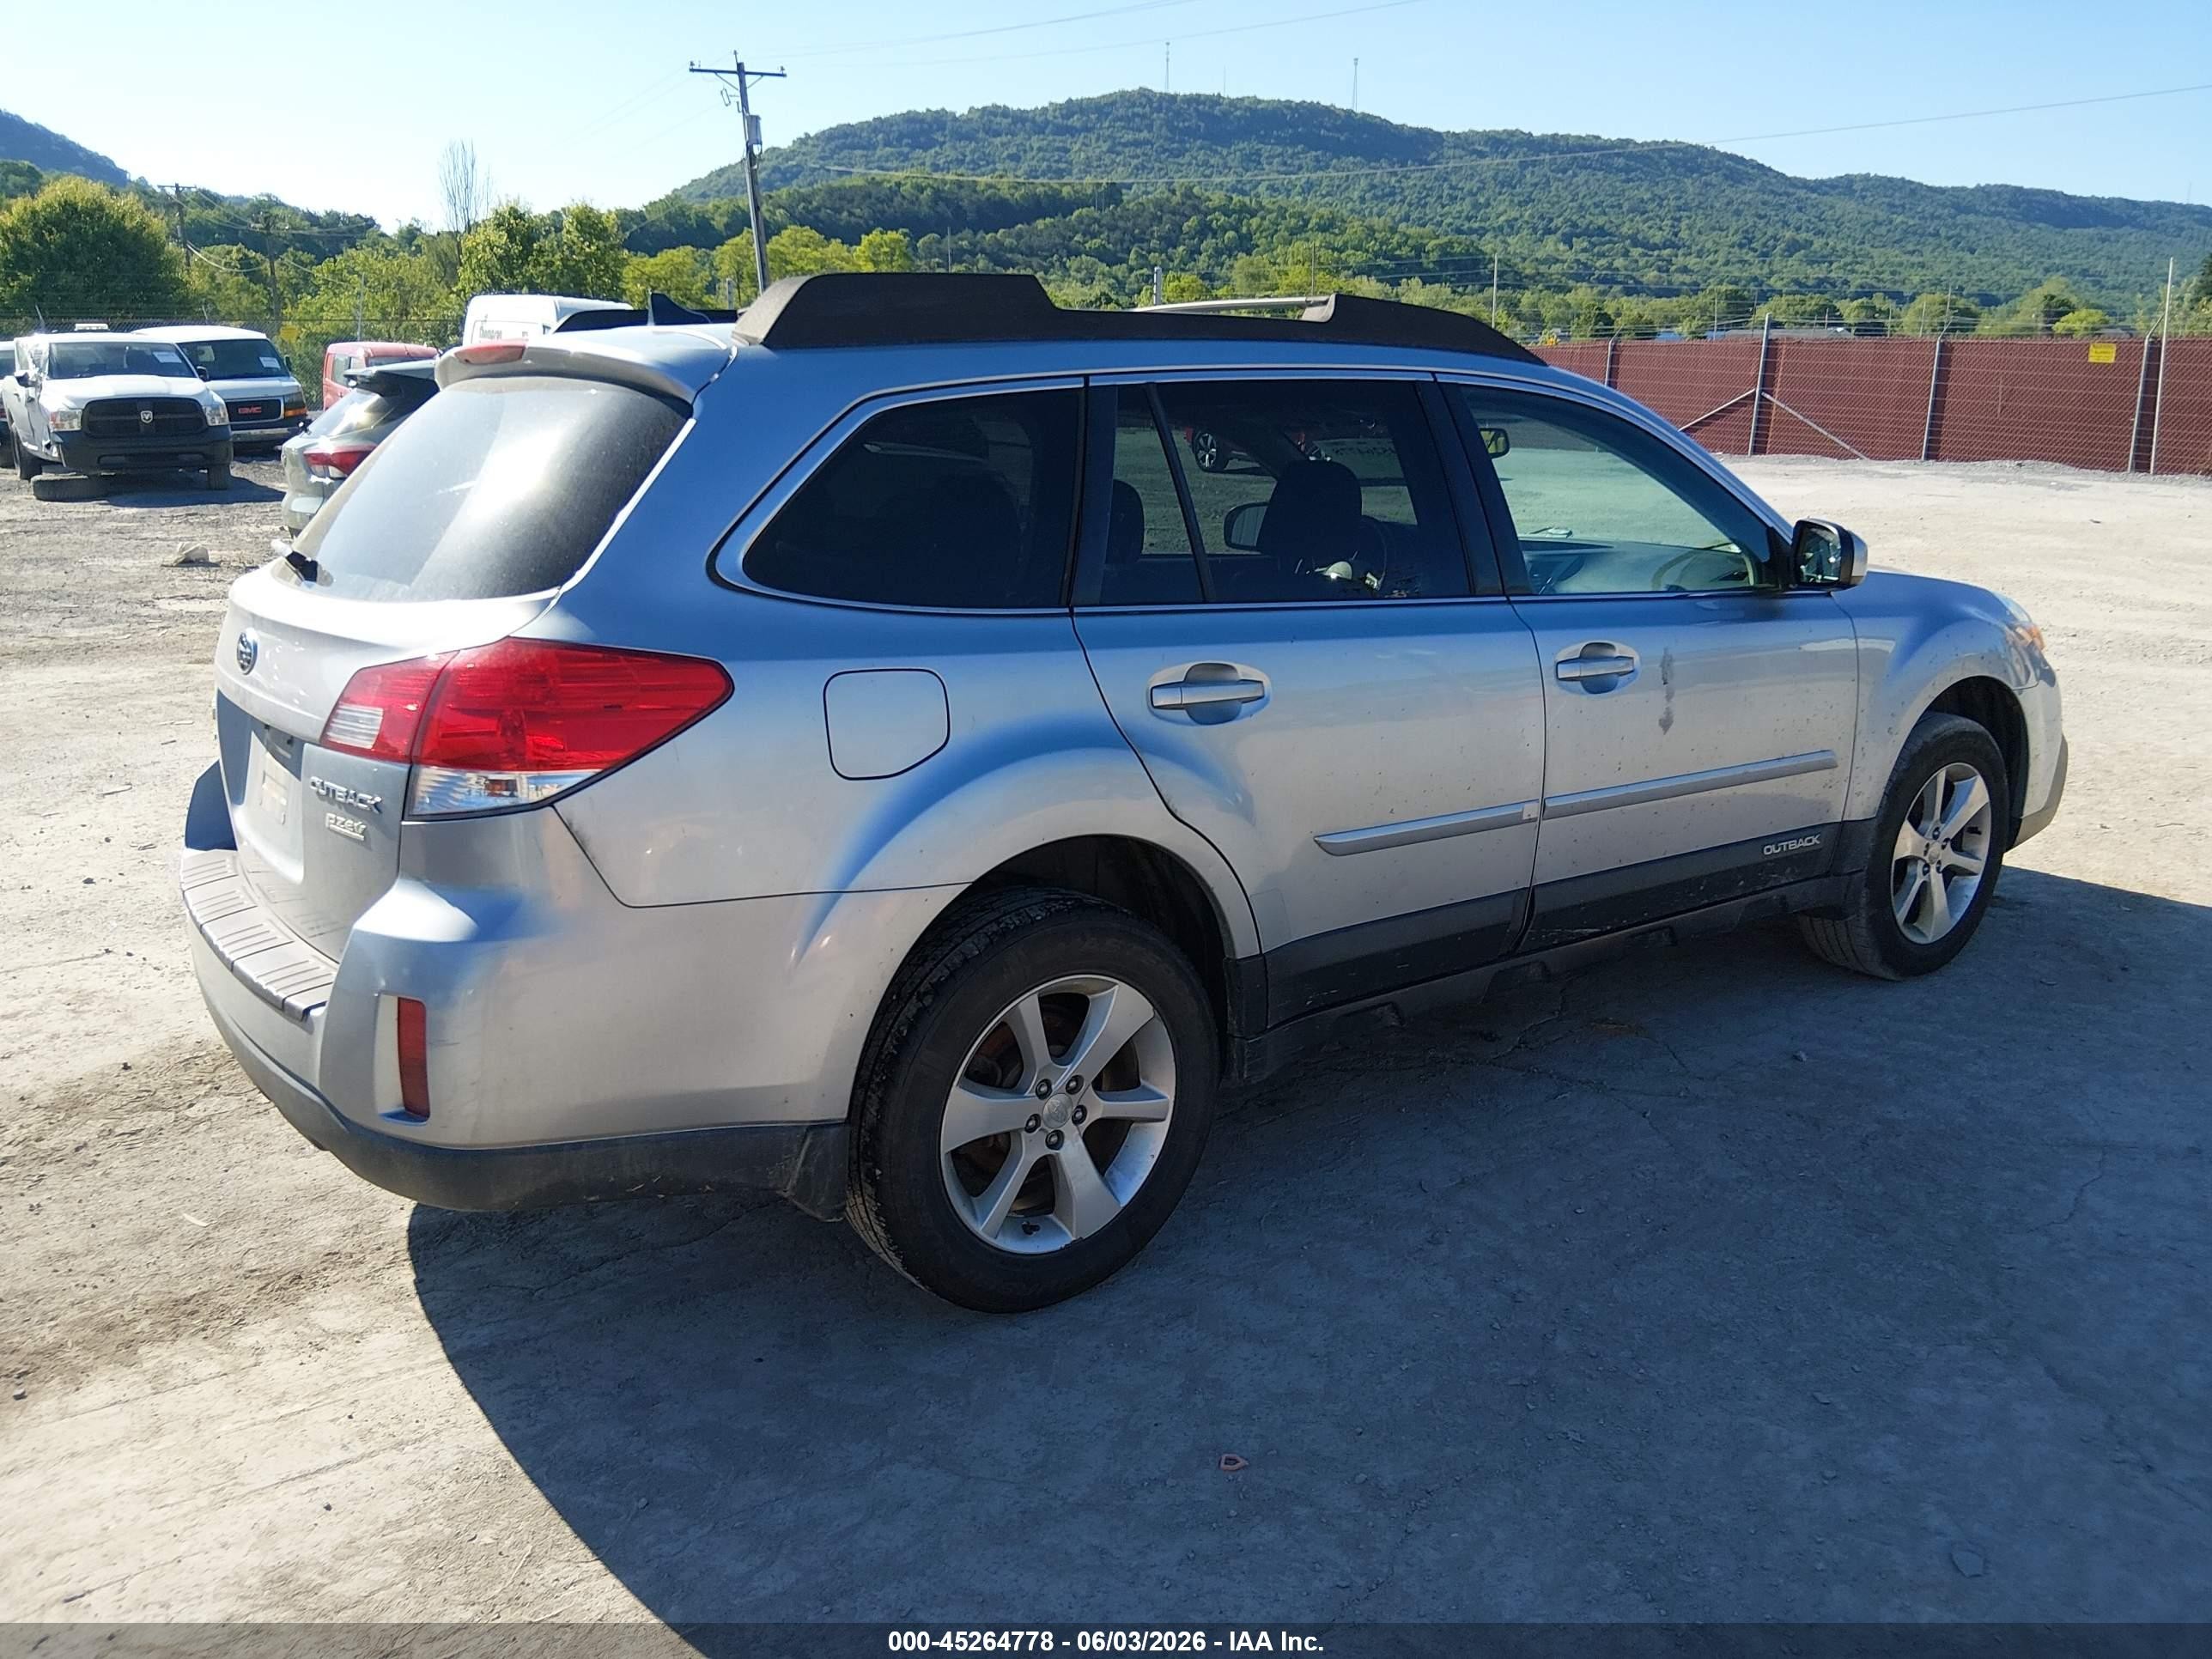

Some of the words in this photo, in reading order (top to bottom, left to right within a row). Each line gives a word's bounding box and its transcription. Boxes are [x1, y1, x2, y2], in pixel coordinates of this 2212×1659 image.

[238, 405, 262, 415] GMC
[309, 775, 383, 815] OUTBACK
[1763, 833, 1821, 855] OUTBACK
